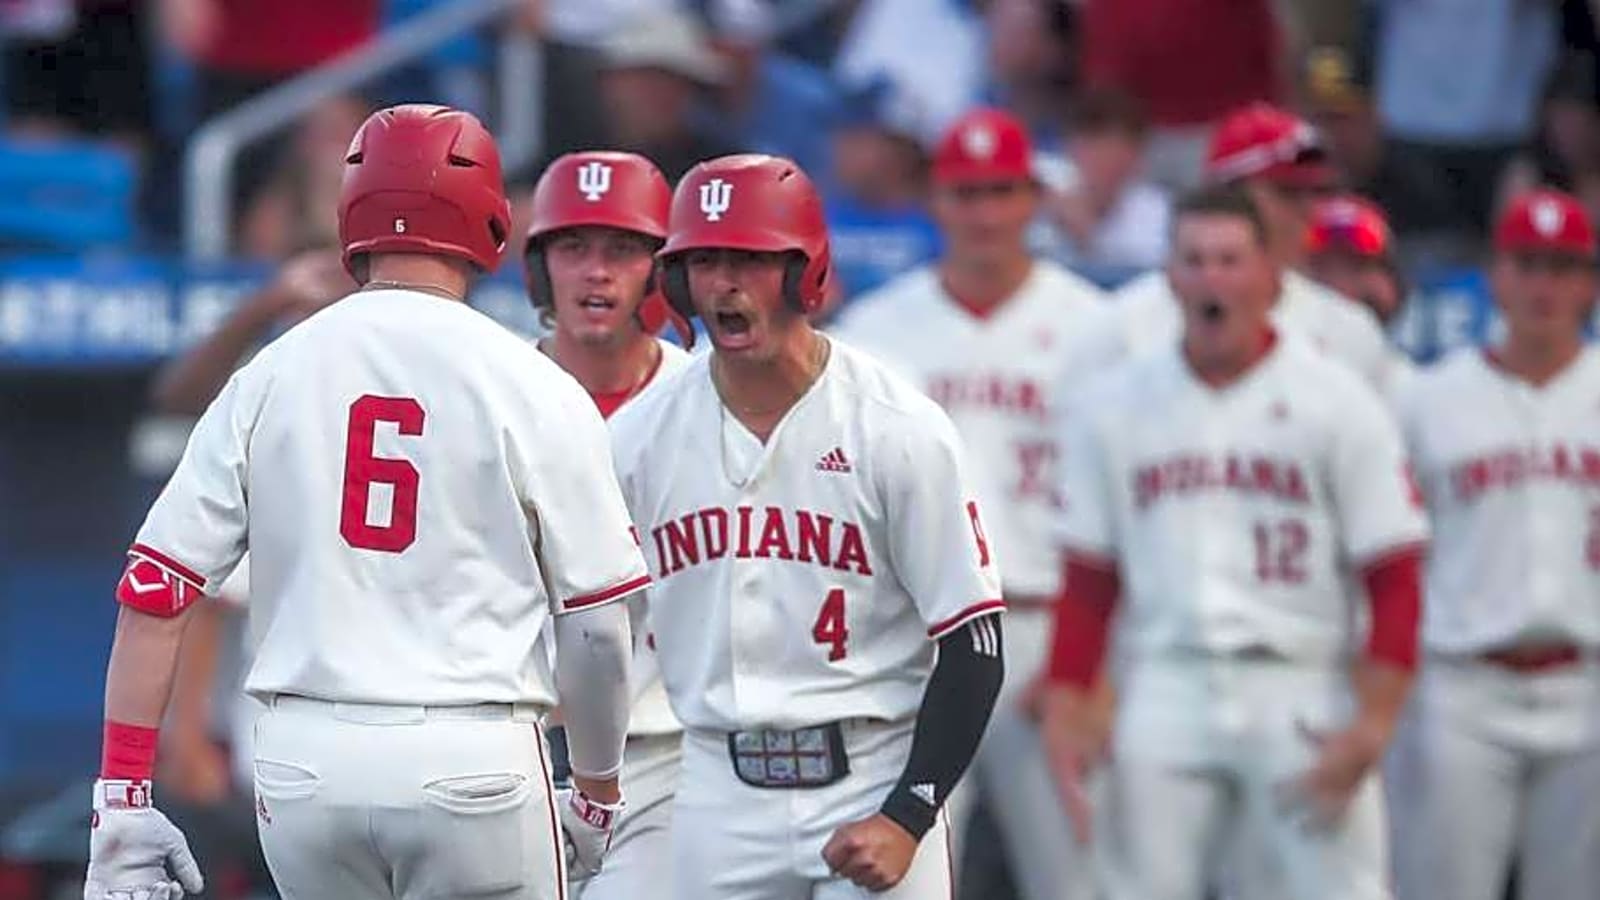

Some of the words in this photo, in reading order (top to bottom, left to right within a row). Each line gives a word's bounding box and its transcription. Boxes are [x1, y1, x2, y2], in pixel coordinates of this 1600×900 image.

[395, 218, 406, 233] 6
[340, 393, 426, 554] 6
[651, 505, 874, 578] INDIANA
[1253, 519, 1310, 584] 12
[812, 587, 849, 663] 4
